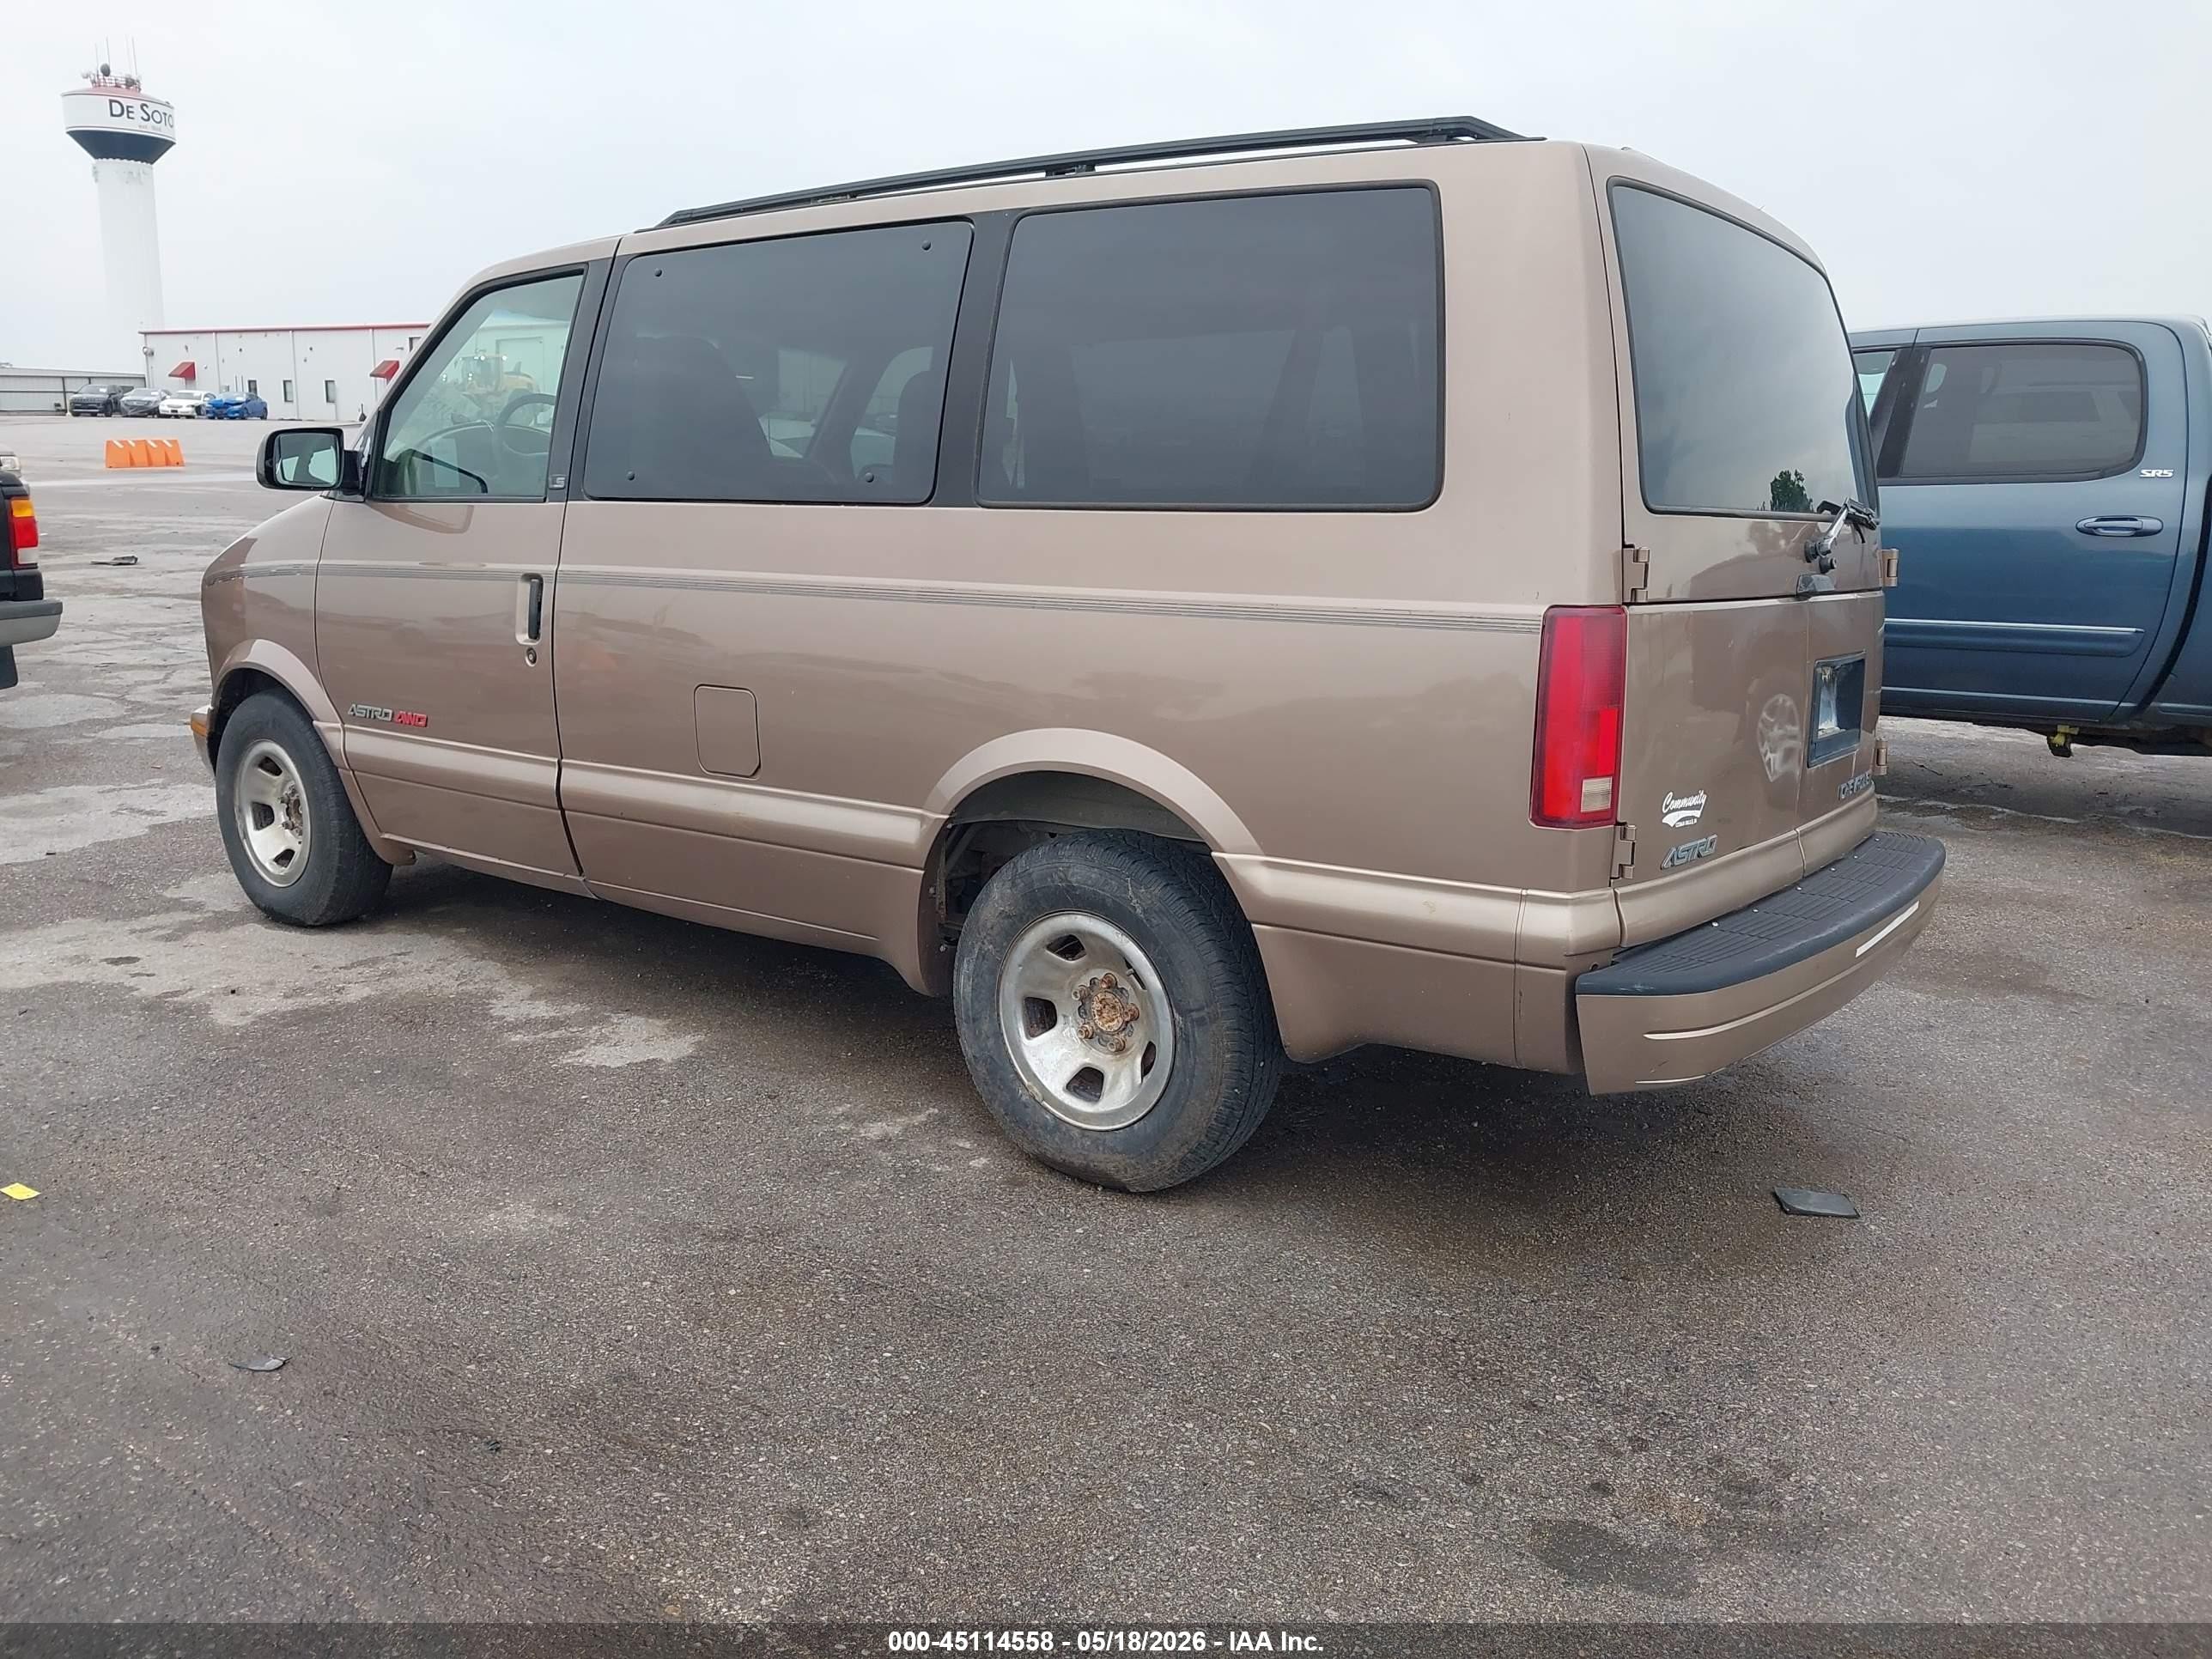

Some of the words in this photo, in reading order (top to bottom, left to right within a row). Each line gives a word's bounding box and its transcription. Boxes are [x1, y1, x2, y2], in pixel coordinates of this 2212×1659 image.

[2139, 469, 2174, 477] SR5
[348, 703, 393, 721] ASTRO
[396, 710, 428, 727] AWD
[1662, 790, 1707, 814] Community
[1661, 834, 1717, 869] ASTRO
